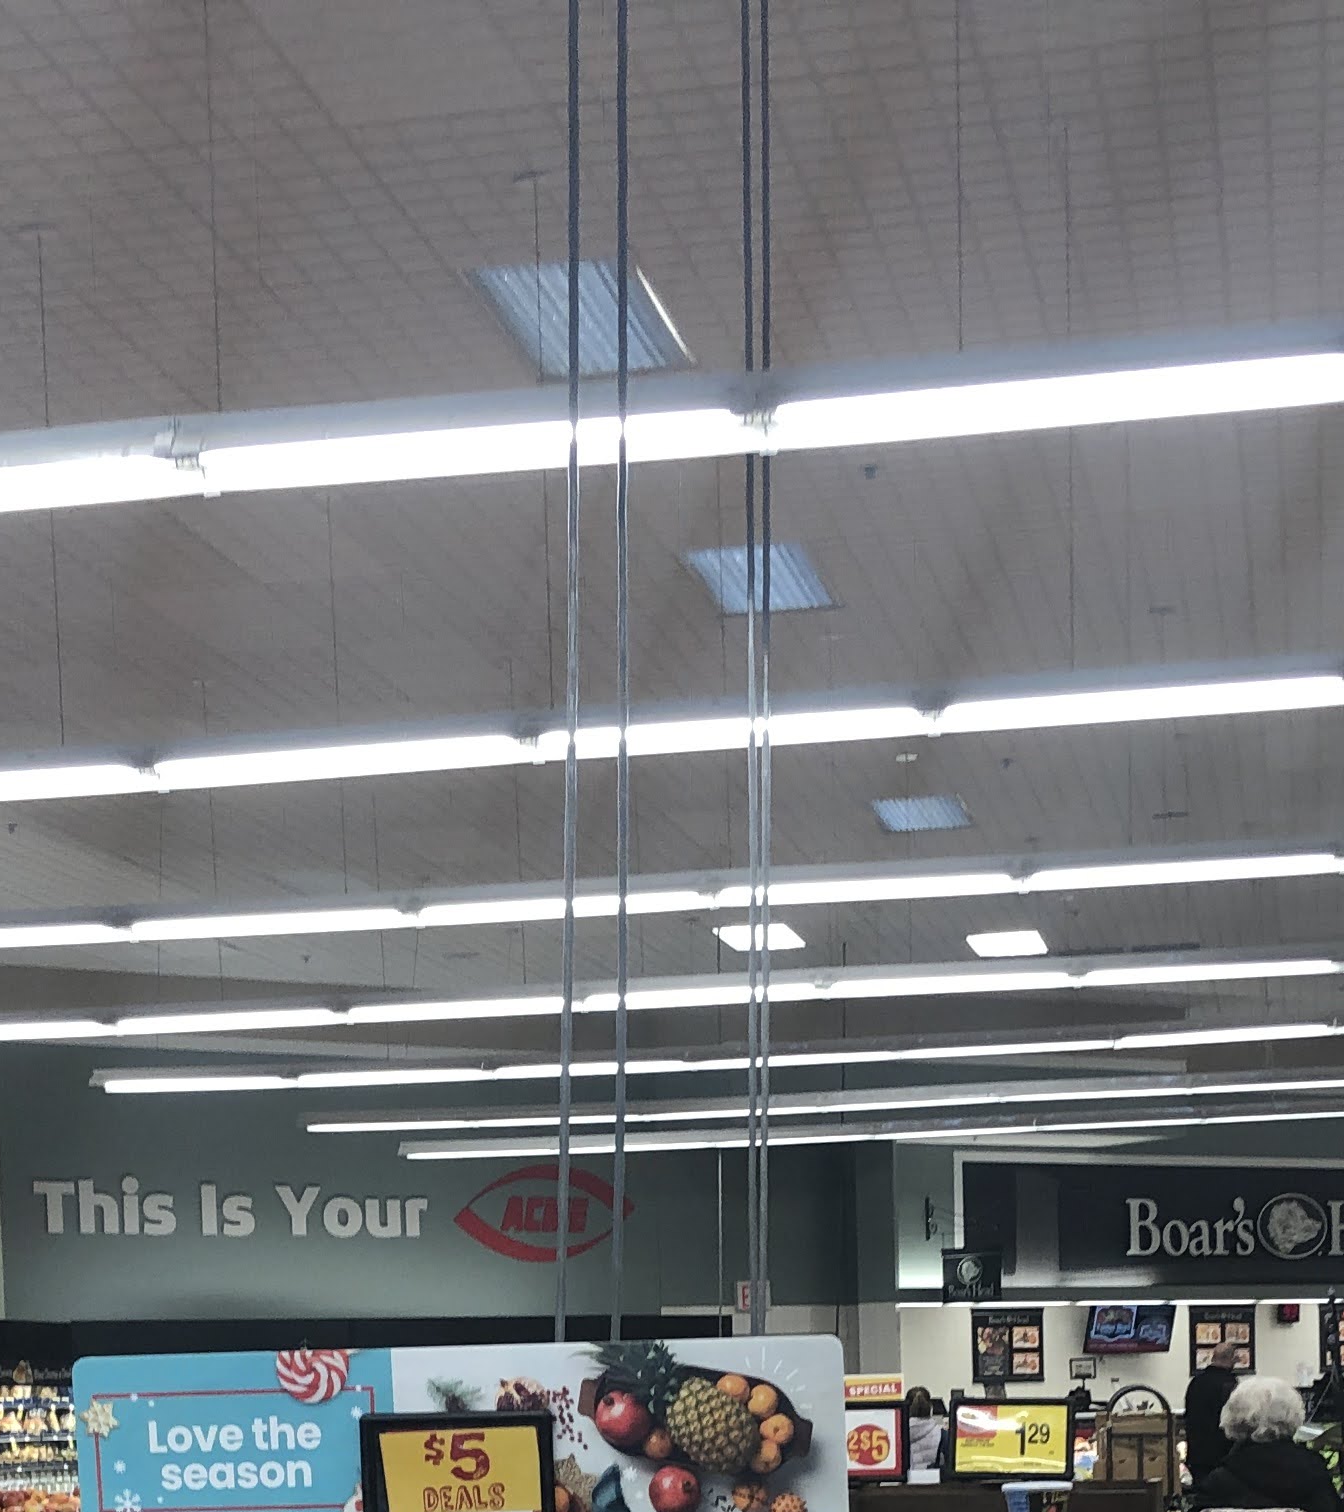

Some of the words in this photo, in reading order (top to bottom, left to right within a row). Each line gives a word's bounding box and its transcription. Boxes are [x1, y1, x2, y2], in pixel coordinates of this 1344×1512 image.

[33, 1176, 177, 1237] This
[200, 1182, 255, 1238] Is
[275, 1185, 428, 1239] Your
[1126, 1198, 1256, 1258] Boar's
[849, 1384, 898, 1396] SPECIAL
[148, 1418, 244, 1456] Love
[251, 1415, 322, 1451] the
[423, 1431, 491, 1482] $5
[161, 1455, 313, 1493] season
